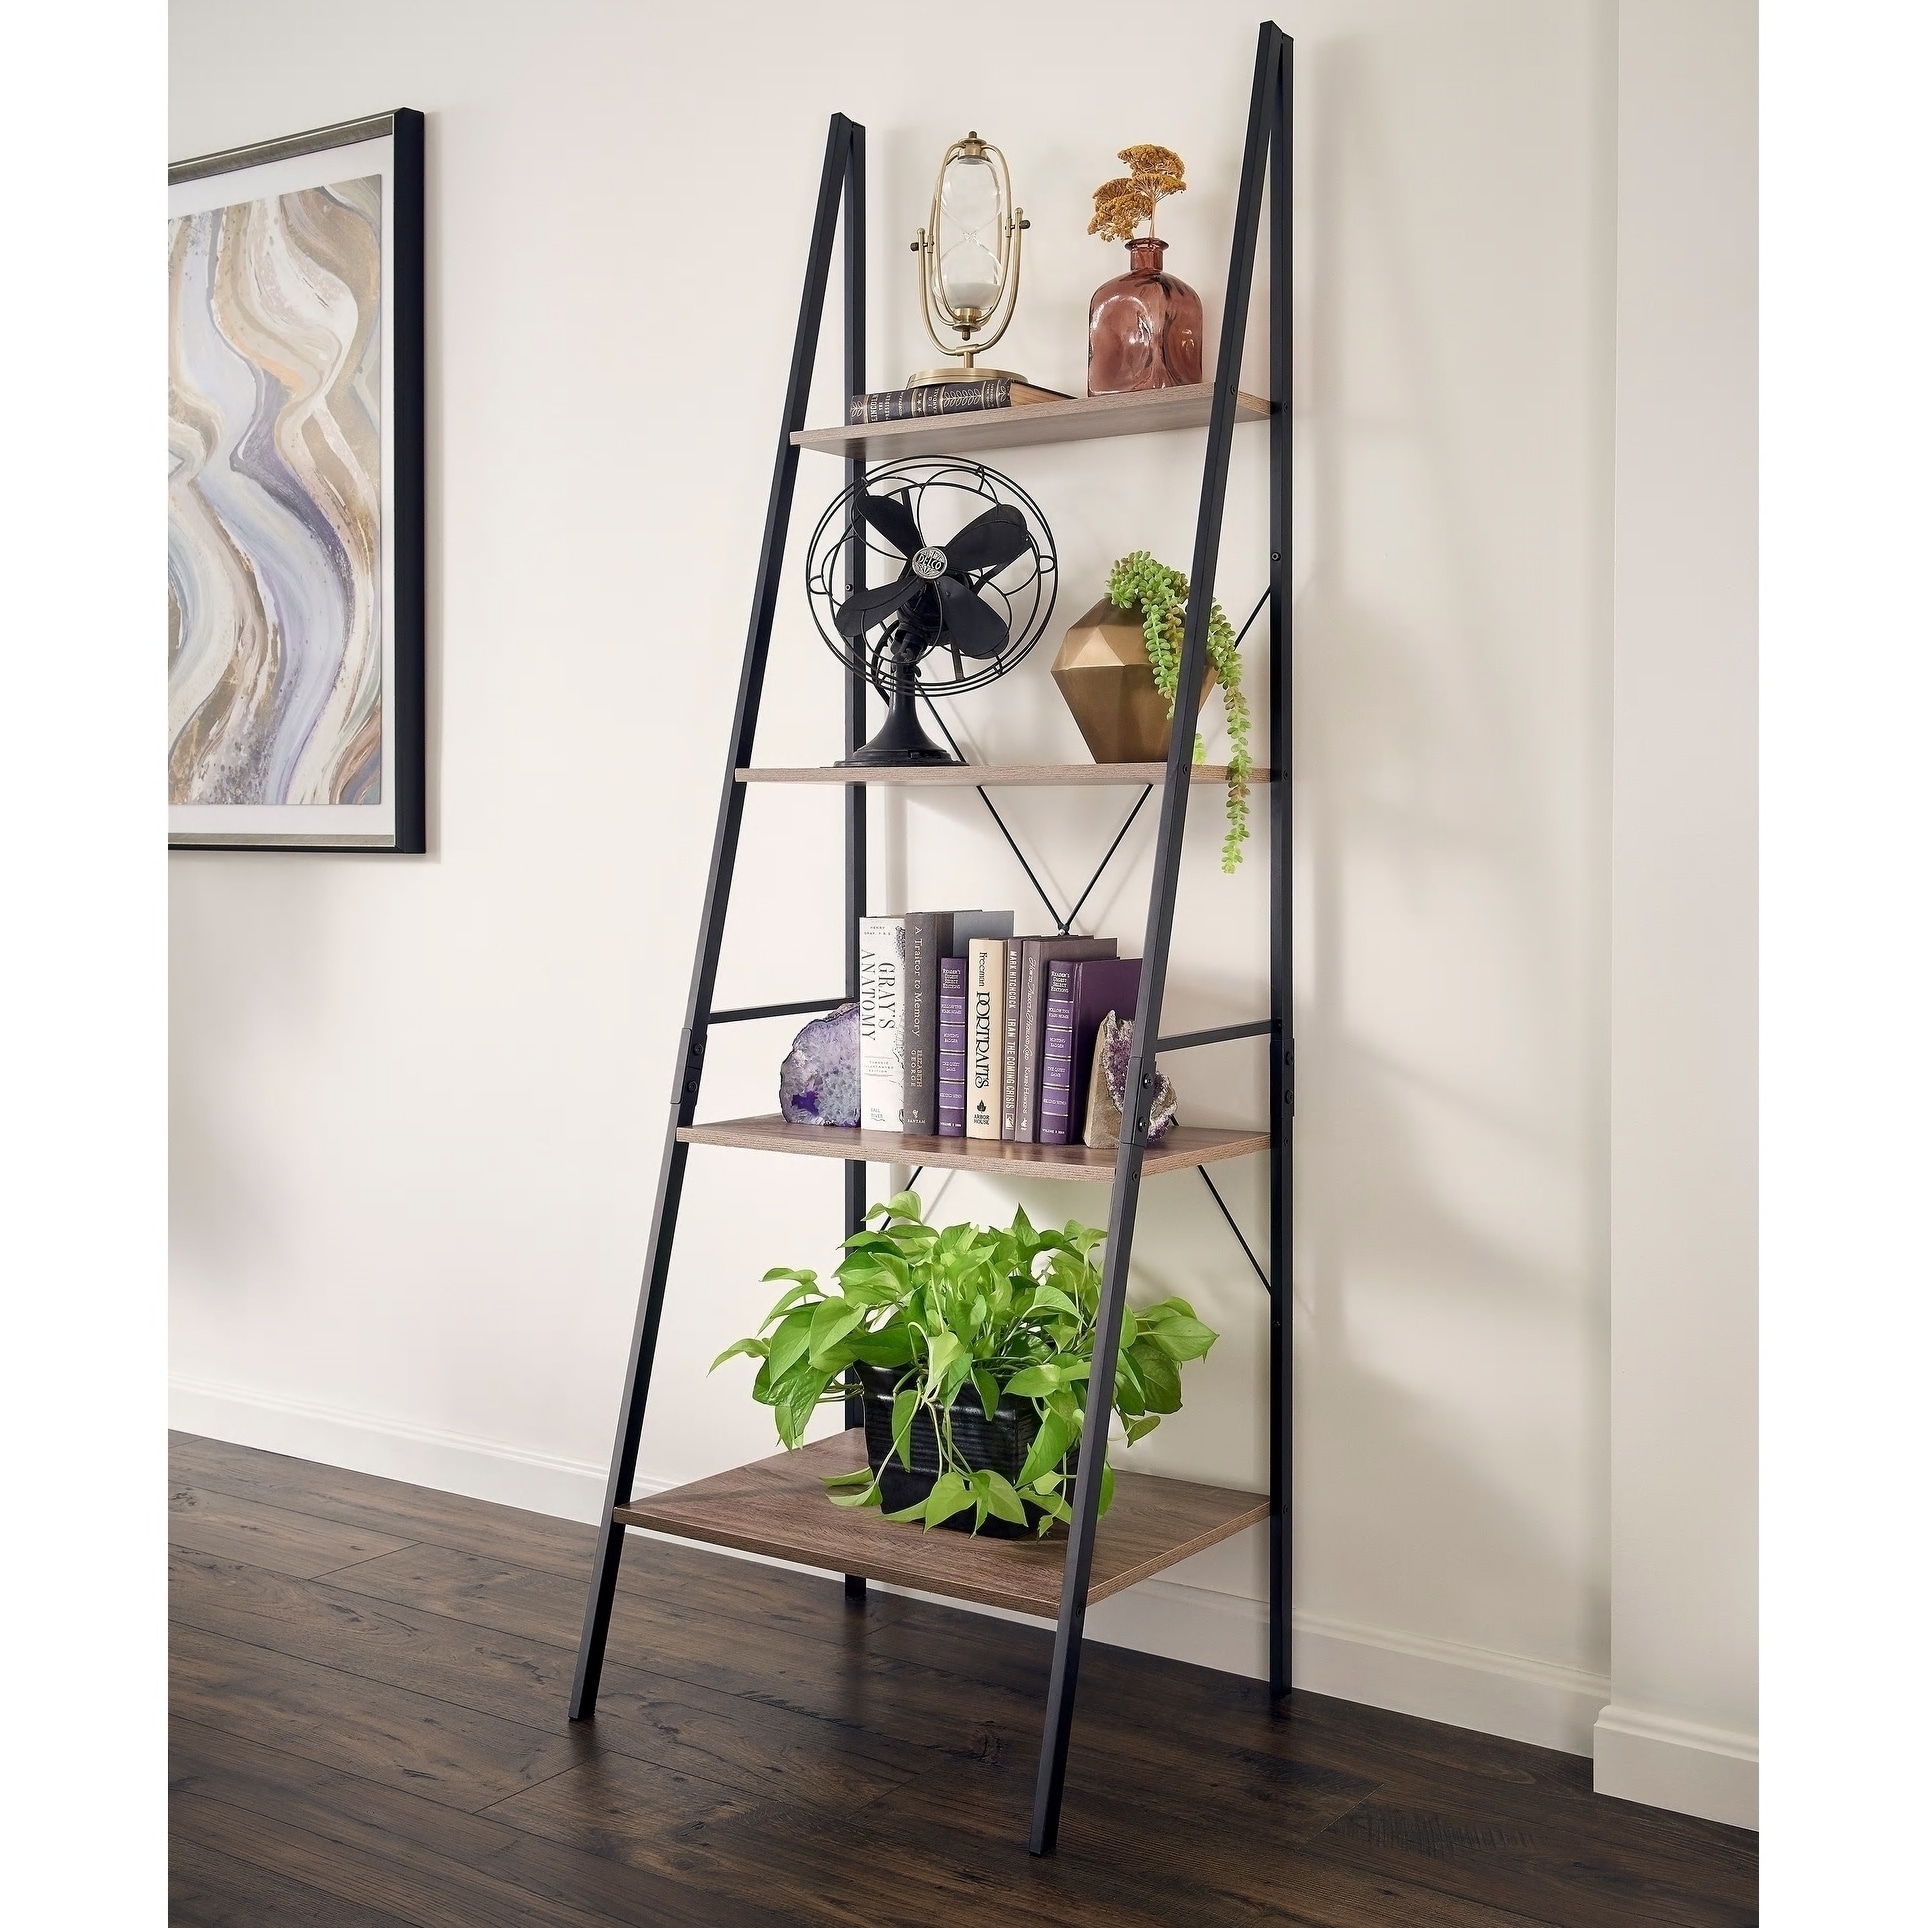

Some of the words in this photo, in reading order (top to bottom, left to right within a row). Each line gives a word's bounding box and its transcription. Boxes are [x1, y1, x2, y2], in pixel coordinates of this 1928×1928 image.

[914, 926, 922, 934] A
[914, 938, 923, 975] Traitor
[979, 952, 987, 987] Freeman
[1009, 951, 1017, 970] MARK
[861, 949, 876, 1041] ANATOMY
[878, 962, 896, 1030] GRAY'S
[914, 979, 922, 988] to
[1008, 971, 1017, 1009] HITCHCOCK
[911, 992, 922, 1037] Memory
[1007, 1018, 1017, 1038] IRAN
[975, 991, 990, 1089] PORTRAITS
[1006, 1041, 1016, 1055] THE
[1006, 1056, 1016, 1084] COMING
[1005, 1085, 1015, 1109] CRISIS
